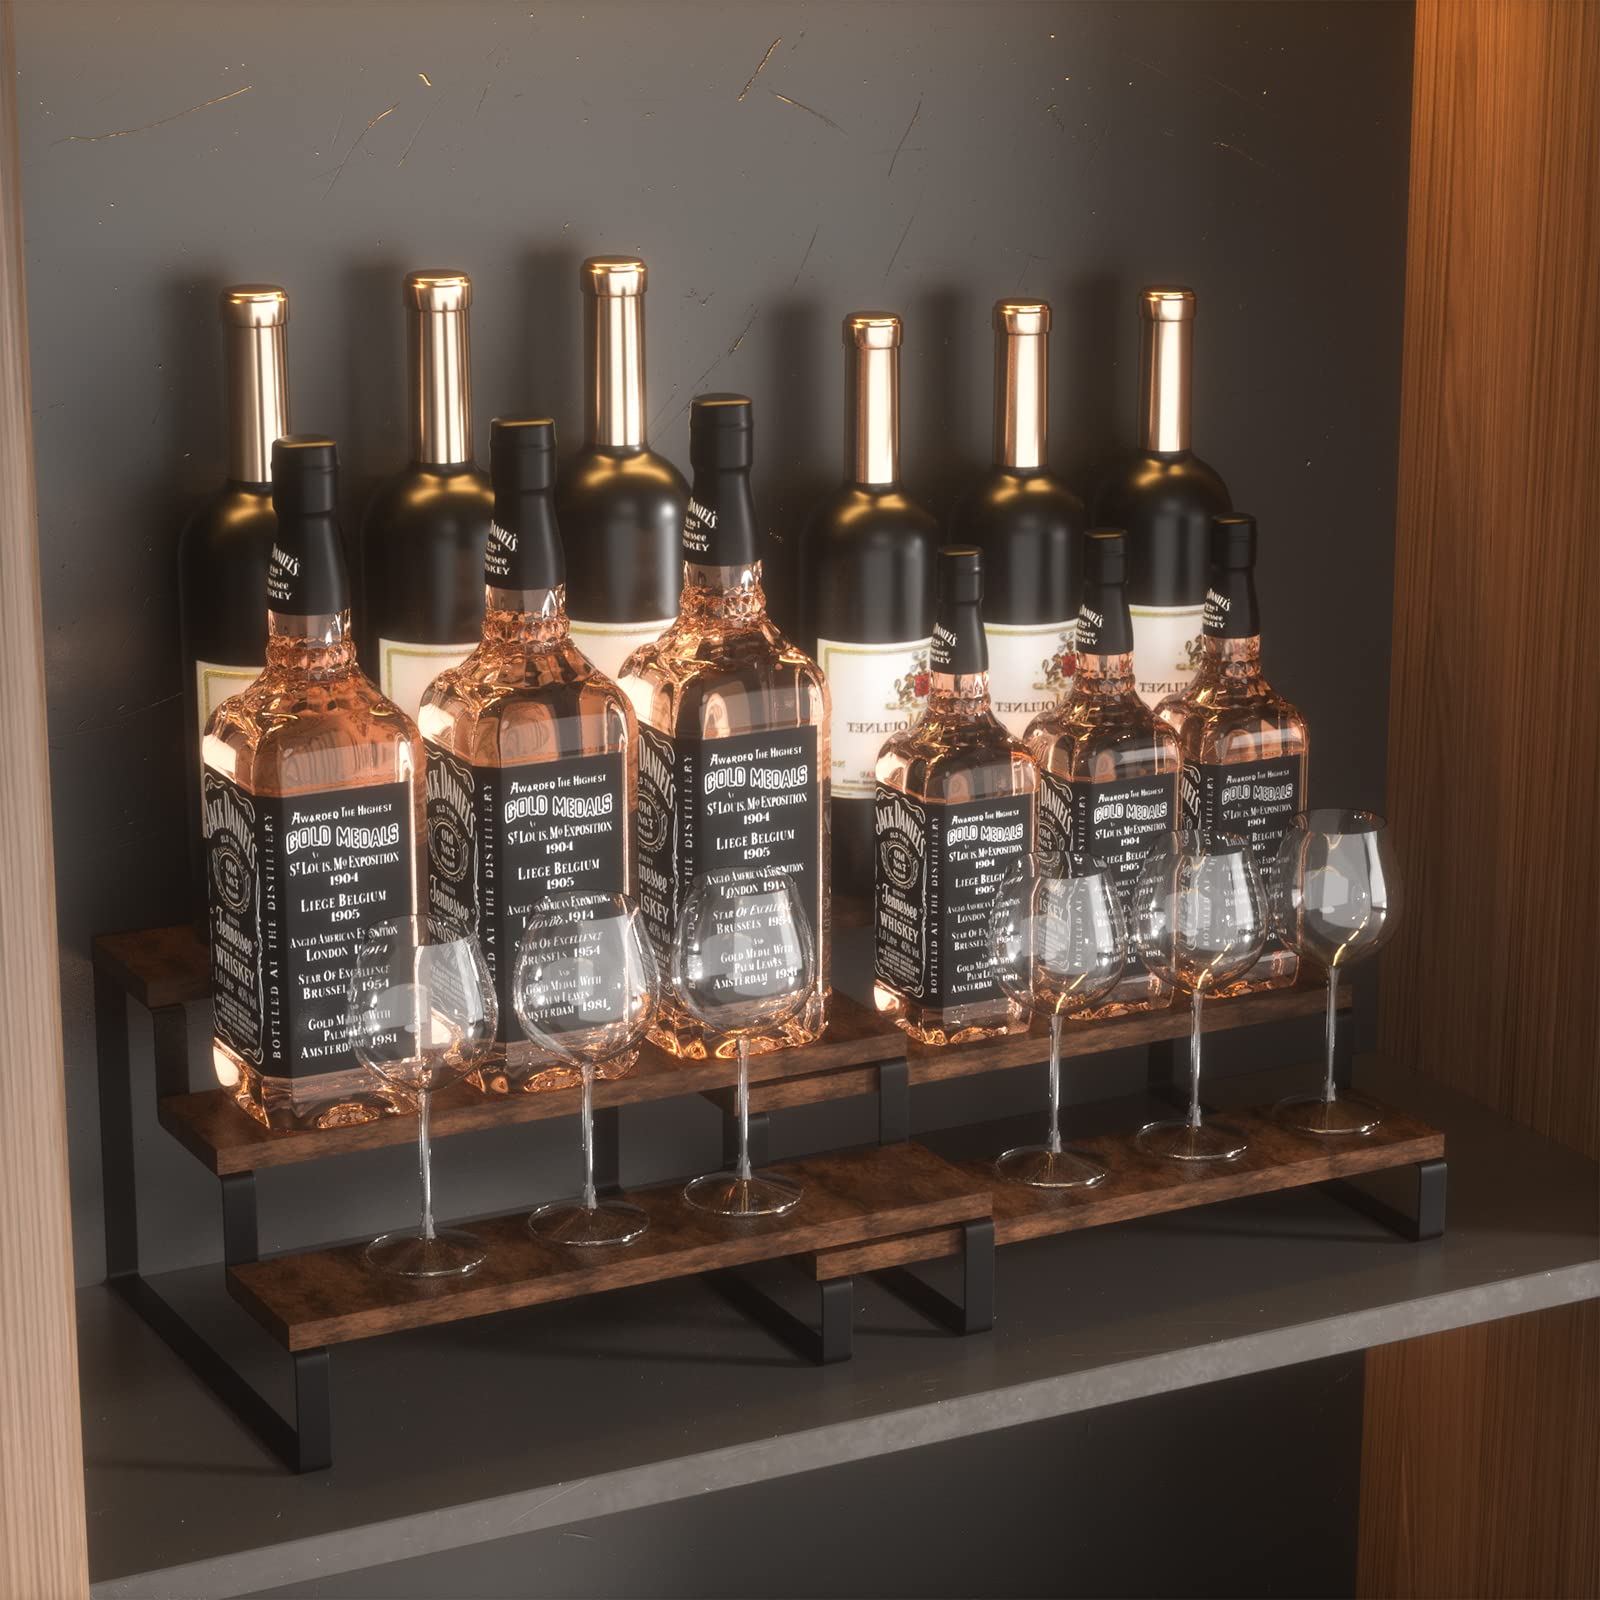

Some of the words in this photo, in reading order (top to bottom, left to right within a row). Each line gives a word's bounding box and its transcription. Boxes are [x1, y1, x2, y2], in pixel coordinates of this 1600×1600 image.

[704, 767, 746, 795] GOLD
[750, 765, 808, 789] MEDALS
[1222, 784, 1250, 805] GOLD
[1253, 783, 1293, 801] MEDALS
[505, 795, 548, 824] GOLD
[552, 793, 612, 818] MEDALS
[1094, 803, 1123, 824] GOLD
[1126, 802, 1168, 820] MEDALS
[743, 811, 770, 825] 1904
[286, 825, 331, 855] GOLD
[336, 823, 399, 848] MEDALS
[716, 836, 748, 850] LIEGE
[751, 829, 795, 845] BELGIUM
[947, 825, 978, 846] GOLD
[980, 823, 1023, 842] MEDALS
[1121, 837, 1140, 846] 1904
[546, 841, 574, 854] 1904
[743, 847, 771, 860] 1905
[975, 858, 995, 869] 1904
[1105, 854, 1124, 864] IEGE
[518, 866, 551, 880] LIEGE
[554, 858, 600, 875] BELGIUM
[1120, 863, 1140, 872] 1905
[330, 872, 359, 886] 1904
[546, 877, 575, 890] 1905
[763, 880, 787, 891] 1914
[955, 877, 979, 888] LIEGE
[975, 885, 995, 895] 1905
[301, 897, 336, 913] LIEGE
[338, 890, 387, 907] BELGIUM
[640, 892, 669, 925] ISKEY
[331, 908, 360, 922] 1905
[880, 910, 919, 944] WHISKEY
[306, 946, 348, 962] LONDON
[574, 945, 601, 958] 1954
[215, 944, 255, 990] WHISKEY
[362, 978, 389, 991] 1954
[308, 1018, 334, 1031] GOLD
[372, 1033, 398, 1046] 1981
